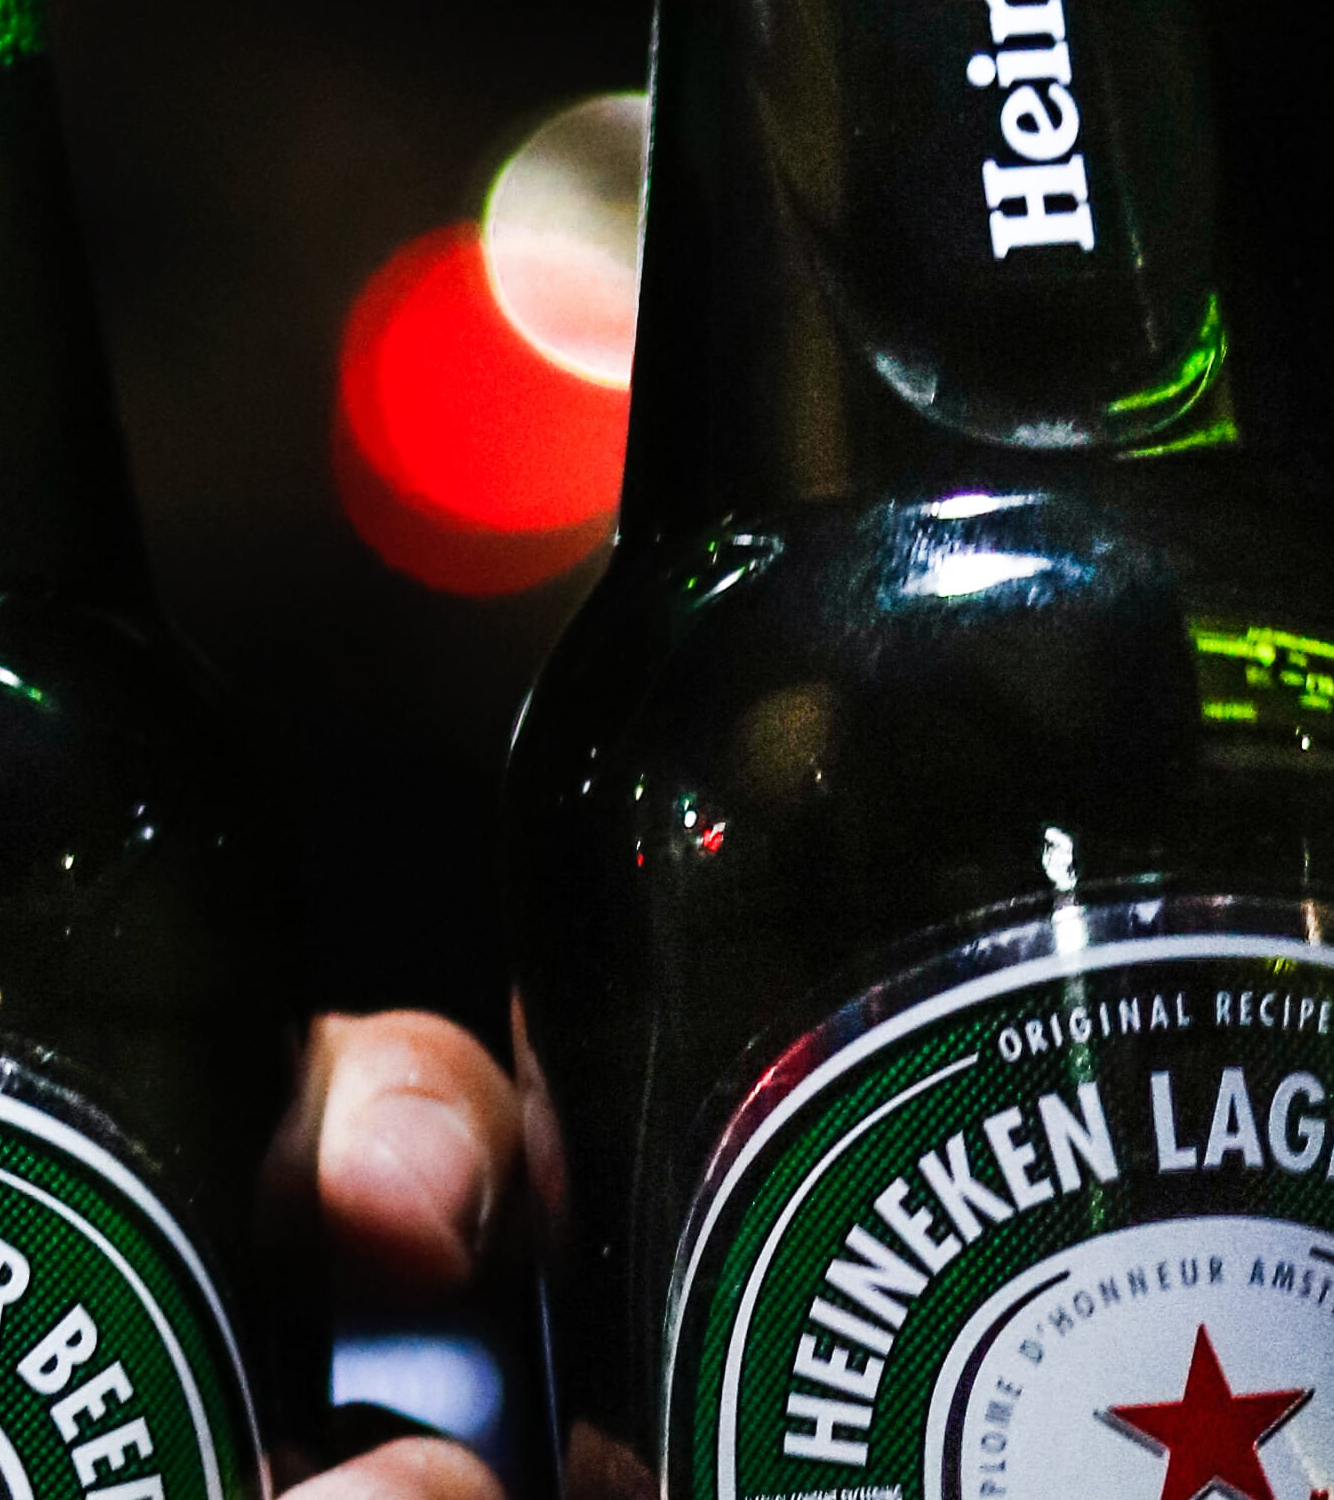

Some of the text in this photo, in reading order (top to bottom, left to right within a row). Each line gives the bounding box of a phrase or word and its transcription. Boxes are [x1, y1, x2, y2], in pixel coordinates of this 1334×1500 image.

[999, 989, 1334, 1065] ORIGINAL RECIPE
[783, 1081, 1120, 1467] HEINEKEN
